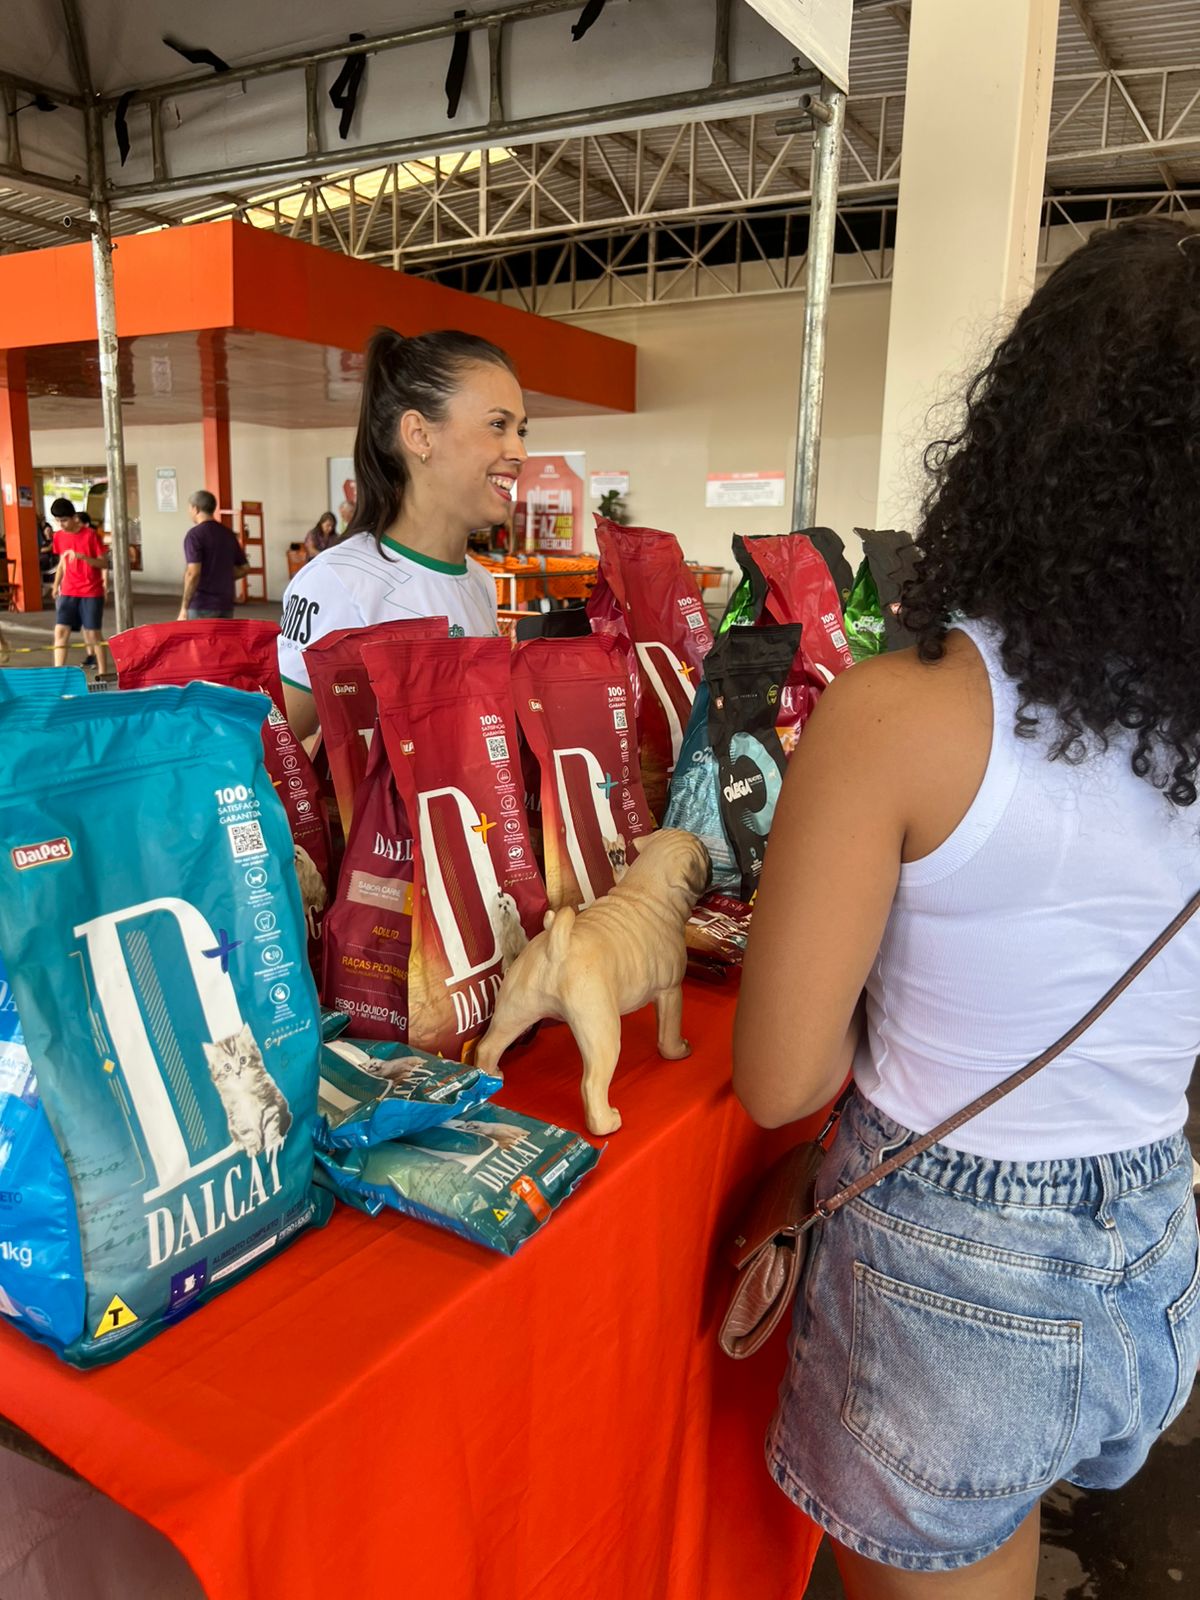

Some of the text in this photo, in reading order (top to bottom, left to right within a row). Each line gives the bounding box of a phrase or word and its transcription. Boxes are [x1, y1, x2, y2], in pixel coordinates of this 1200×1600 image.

[371, 925, 400, 940] ADULTO
[341, 956, 371, 971] RAÇAS
[335, 996, 408, 1031] PESO LÍQUIDO 1kg
[472, 1135, 545, 1193] DALCAT
[144, 1134, 288, 1270] DALCAT
[0, 1241, 33, 1268] 1kg
[108, 1306, 124, 1327] T
